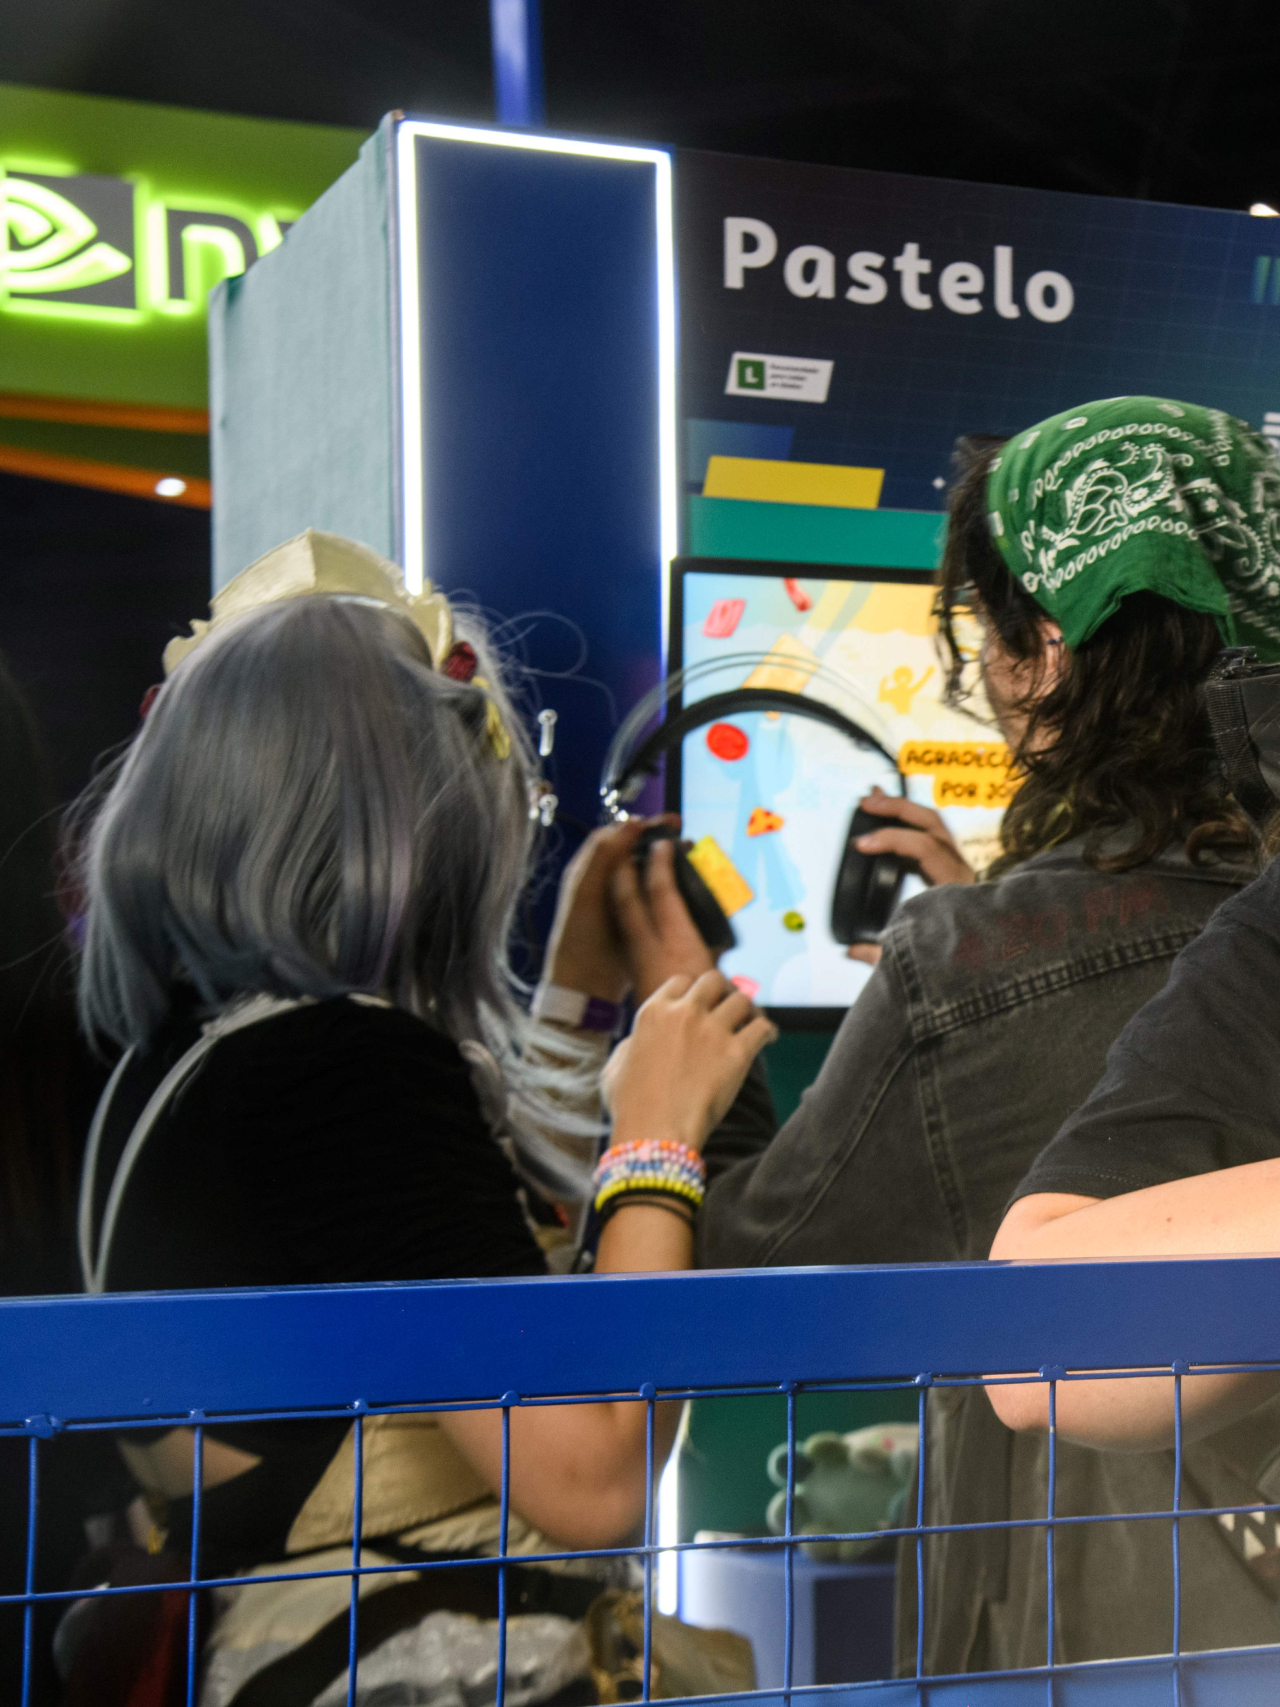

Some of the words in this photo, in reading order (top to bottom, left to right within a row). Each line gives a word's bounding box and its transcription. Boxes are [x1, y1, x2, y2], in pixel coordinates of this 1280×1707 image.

[724, 216, 1075, 324] Pastelo
[906, 749, 1012, 768] AGRADEC
[941, 780, 977, 797] POR
